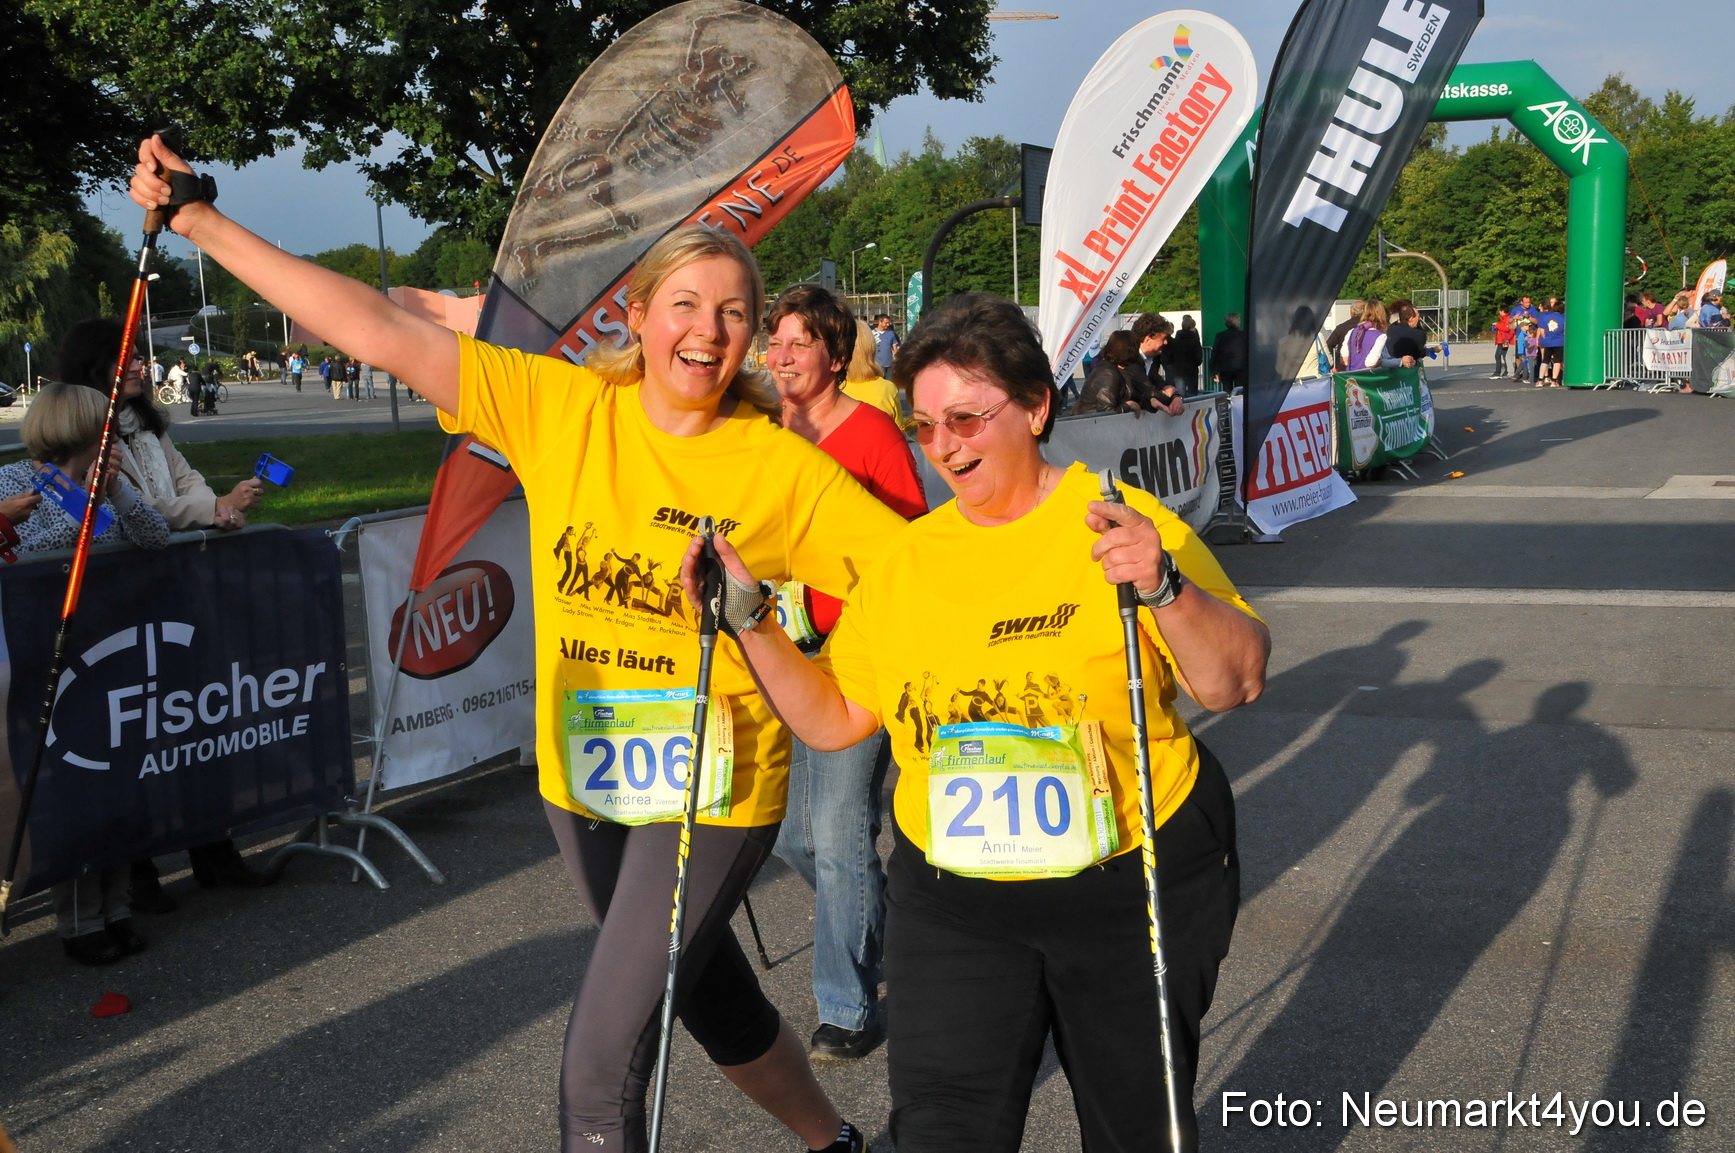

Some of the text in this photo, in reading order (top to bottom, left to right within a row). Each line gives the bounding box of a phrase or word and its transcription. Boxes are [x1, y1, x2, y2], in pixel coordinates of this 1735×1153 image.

[1406, 14, 1441, 73] SWEDEN
[1112, 60, 1184, 159] Frischmann
[1157, 93, 1175, 115] Druck
[1180, 53, 1200, 81] Medien
[1282, 0, 1450, 233] THULE
[1527, 101, 1608, 165] AOK
[1083, 179, 1155, 263] Print
[1132, 62, 1233, 187] Factory
[1120, 438, 1192, 499] swn
[649, 522, 686, 535] stadtwerke
[412, 573, 496, 659] NEU!
[989, 615, 1048, 640] swn
[1024, 630, 1062, 641] neumarkt
[560, 637, 676, 676] Alles läuft
[108, 660, 326, 749] Fischer
[391, 703, 454, 736] AMBERG
[583, 718, 635, 728] firmenlauf
[138, 714, 310, 780] AUTOMOBILE
[583, 736, 690, 790] 206
[948, 753, 1007, 766] firmenlauf
[604, 794, 651, 806] Andrea
[944, 775, 1072, 838] 210
[981, 840, 1016, 854] Anni
